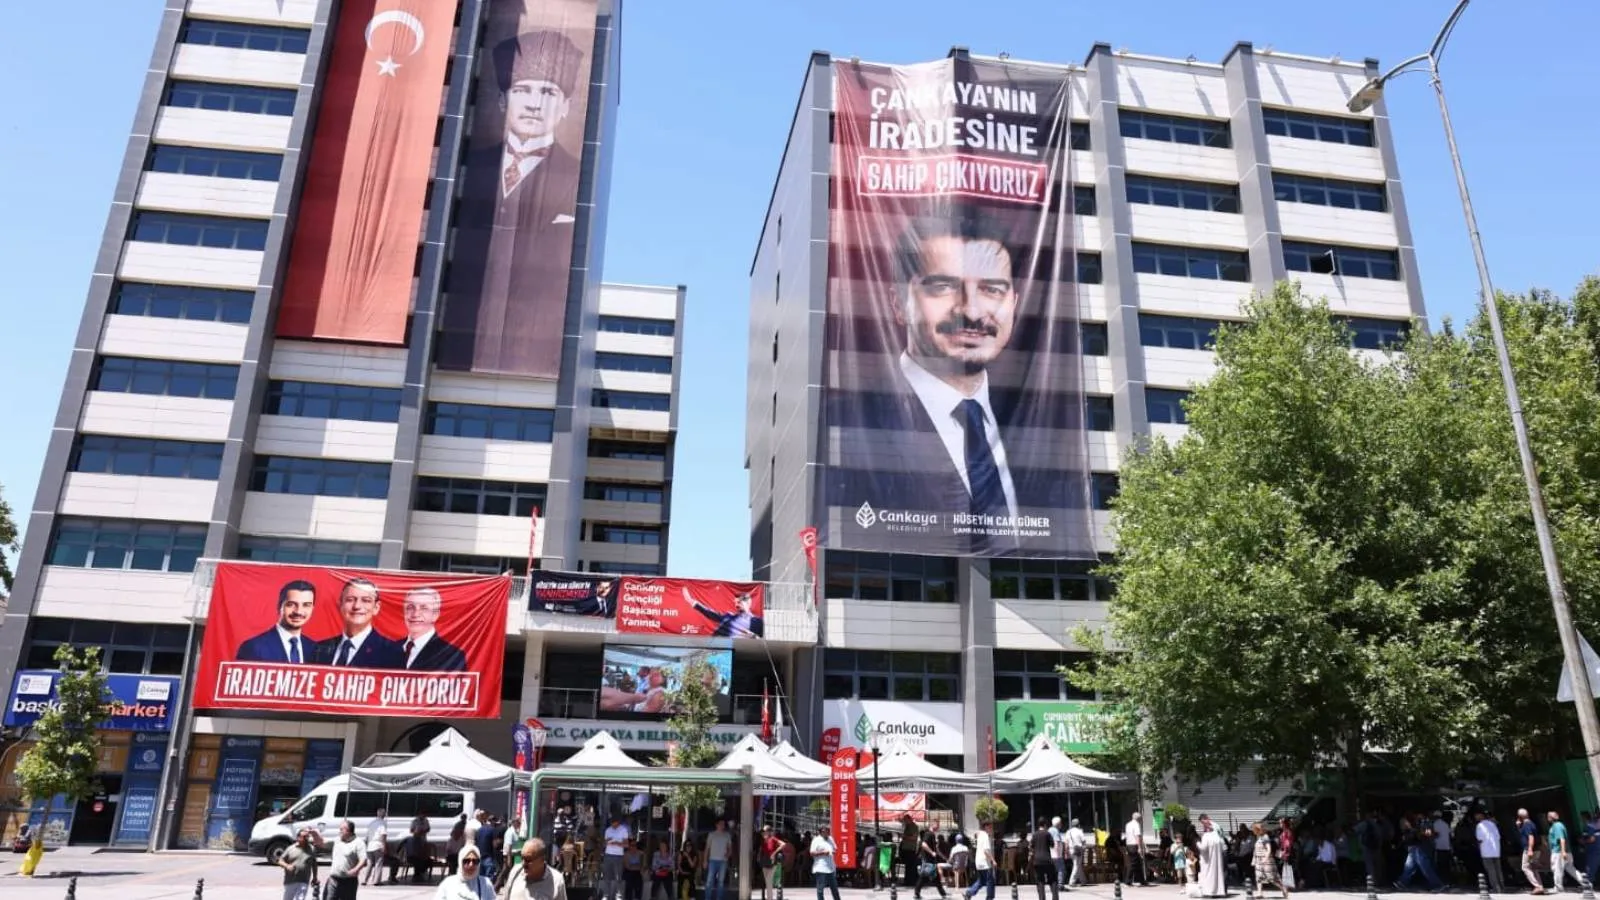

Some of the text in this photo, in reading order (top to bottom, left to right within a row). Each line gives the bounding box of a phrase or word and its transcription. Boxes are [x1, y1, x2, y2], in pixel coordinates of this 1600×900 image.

[871, 81, 1036, 114] ÇANKAYA'NIN
[869, 114, 1038, 155] İRADESİNE
[867, 160, 1039, 198] SAHİP ÇIKIYORUZ
[953, 512, 1050, 527] HÜSEYİN CAN GÜNER
[623, 582, 665, 593] Çankaya
[622, 617, 661, 629] Yanında
[224, 668, 471, 707] İRADEMİZE SAHİP ÇIKIYORUZ
[570, 728, 633, 741] ÇANAYA
